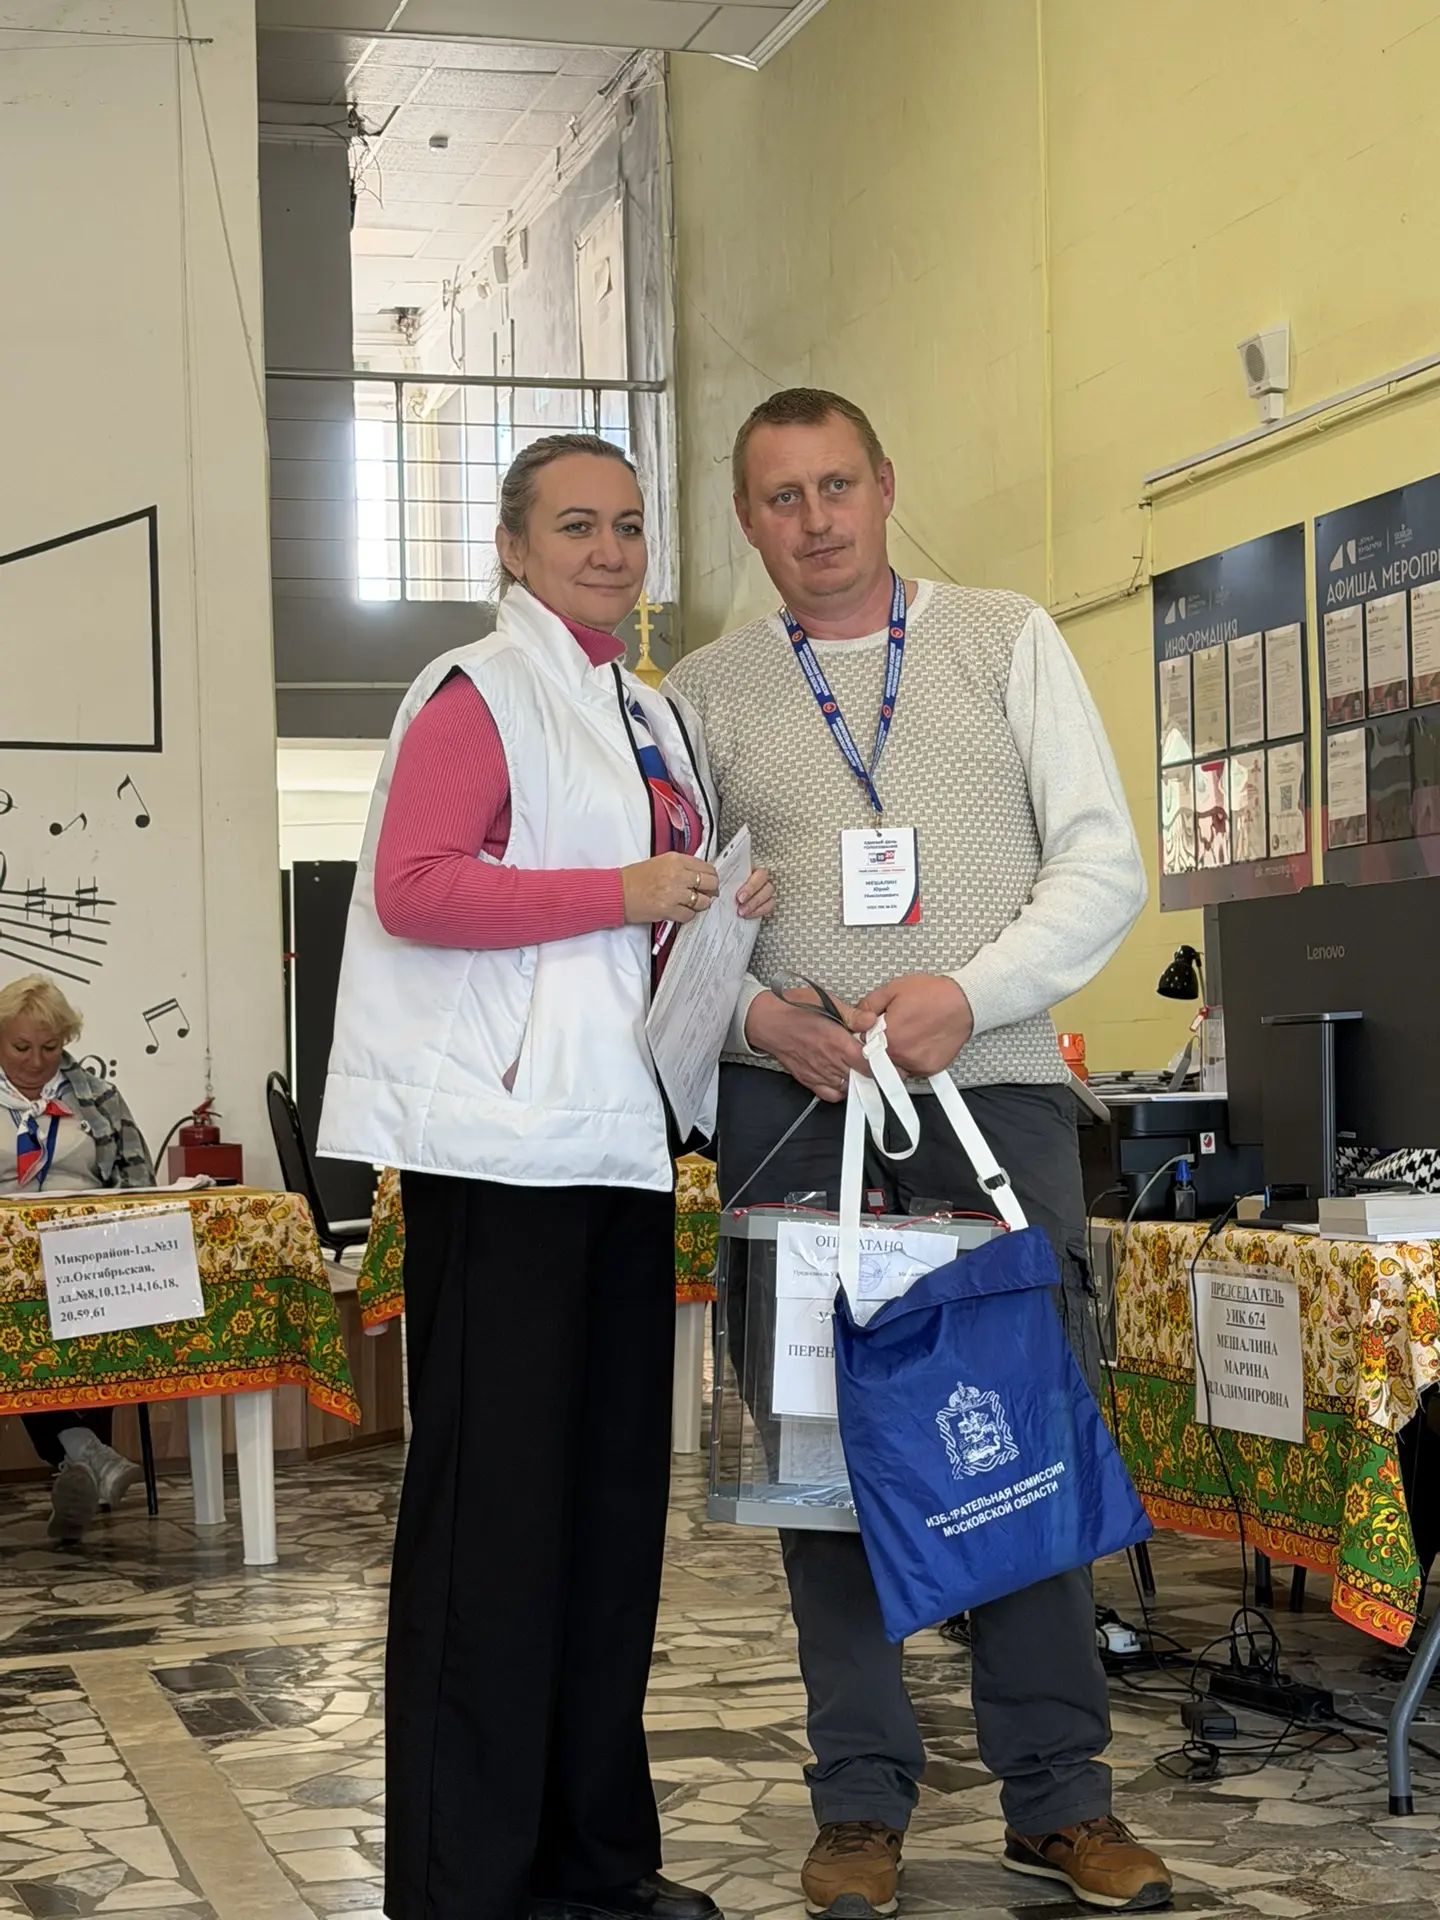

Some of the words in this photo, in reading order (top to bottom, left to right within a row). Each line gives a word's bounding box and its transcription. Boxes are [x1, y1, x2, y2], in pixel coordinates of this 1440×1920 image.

[1326, 570, 1378, 607] АФИША
[1164, 618, 1238, 658] ИНФОРМАЦИЯ
[1306, 944, 1345, 960] Lenovo
[1210, 1281, 1285, 1304] ПРЕДСЕДАТЕЛЬ
[60, 1306, 106, 1323] 20,59,61
[1226, 1308, 1247, 1325] УИК
[1248, 1312, 1266, 1327] 674
[788, 1344, 836, 1359] ПЕРЕН
[1216, 1333, 1279, 1356] МЕШАЛИНА
[1224, 1359, 1270, 1380] МАРИНА
[1013, 1460, 1066, 1495] КОМИССИЯ
[943, 1500, 1013, 1537] МОСКОВСКОЙ
[1014, 1480, 1060, 1509] ОБЛАСТИ
